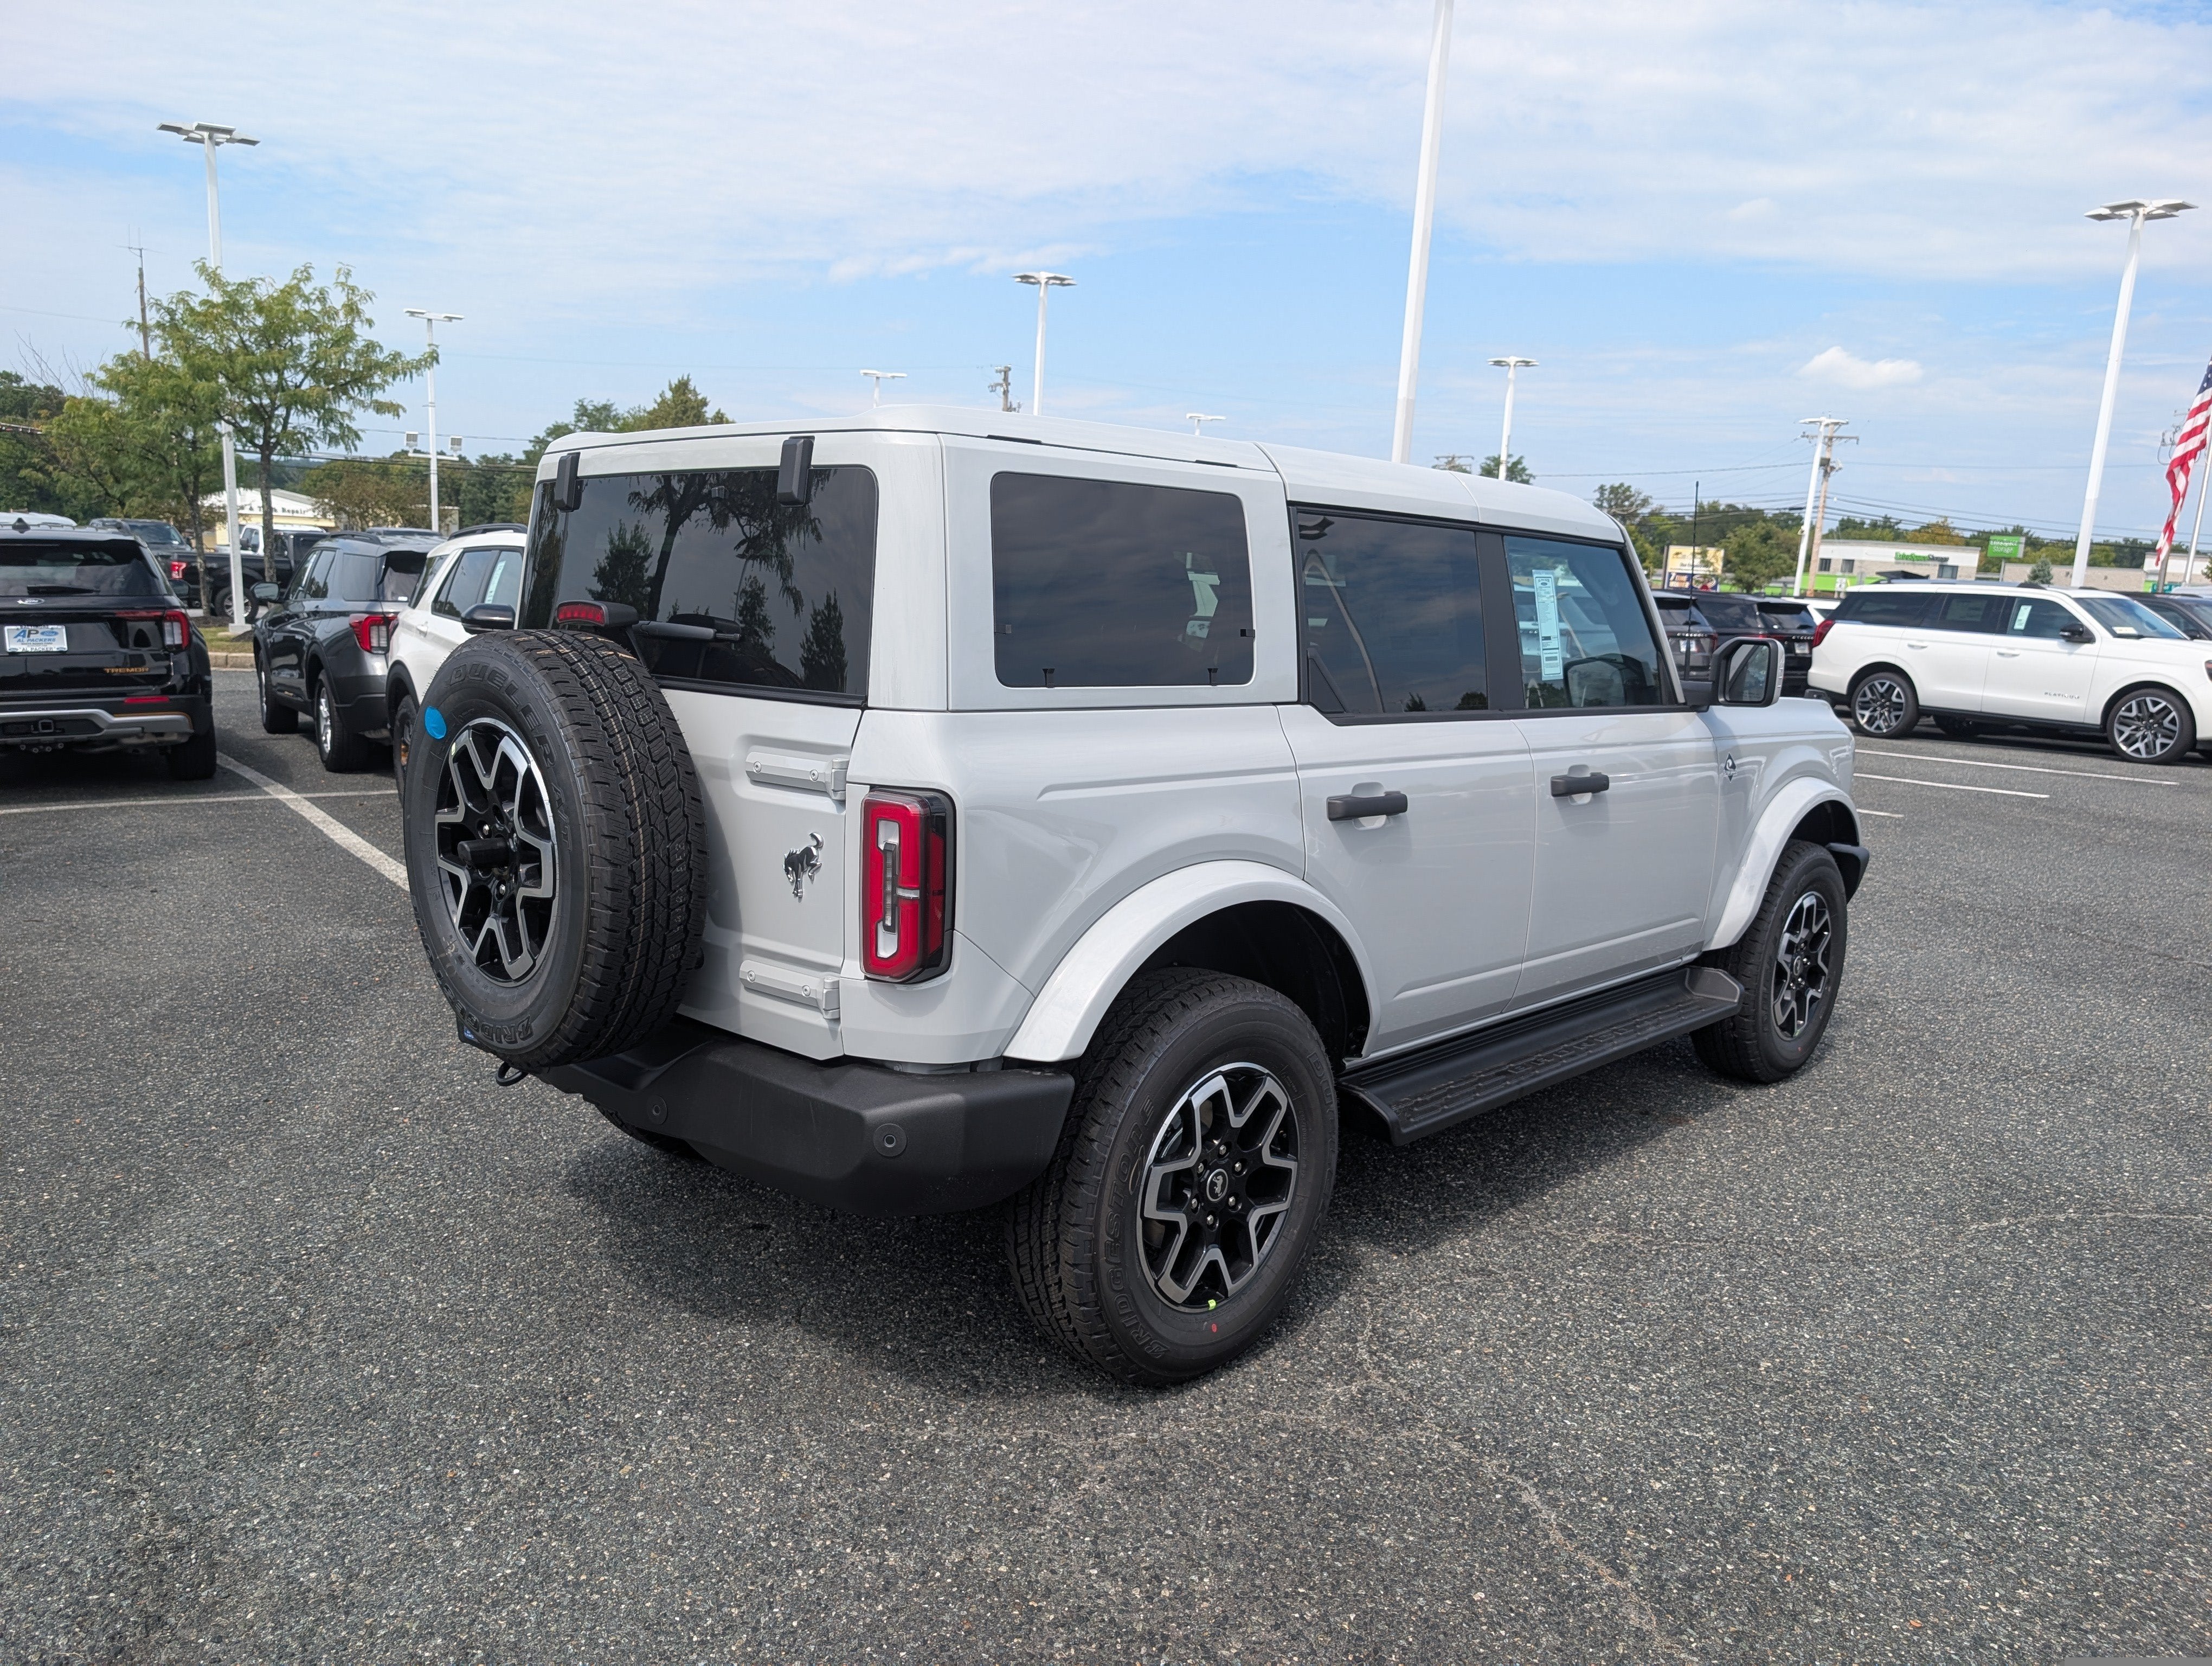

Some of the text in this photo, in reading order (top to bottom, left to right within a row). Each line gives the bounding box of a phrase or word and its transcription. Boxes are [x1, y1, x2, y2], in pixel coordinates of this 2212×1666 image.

[14, 630, 39, 638] AP
[449, 663, 557, 768] DUELER
[1105, 1094, 1171, 1360] BRIDGESTONE
